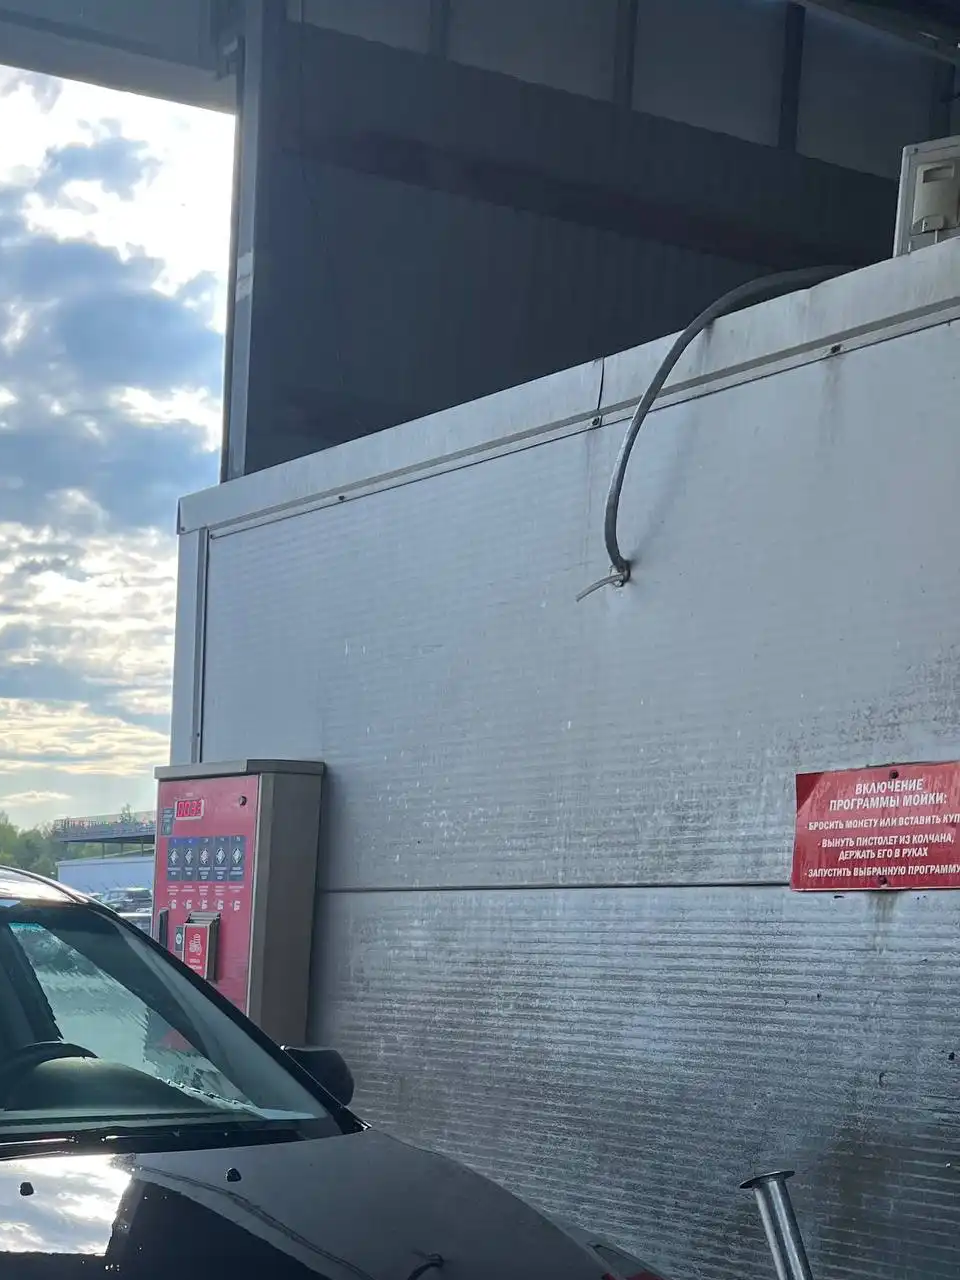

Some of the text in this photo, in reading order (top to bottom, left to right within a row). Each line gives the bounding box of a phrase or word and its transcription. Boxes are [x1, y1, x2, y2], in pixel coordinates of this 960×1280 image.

[855, 779, 924, 795] ВКЛЮЧЕНИЕ
[829, 792, 947, 811] ПРОГРАММЫ МОЙКИ:
[808, 821, 844, 831] БРОСИТЬ
[845, 818, 878, 829] МОНЕТУ
[879, 817, 898, 827] ИЛИ
[899, 815, 941, 826] ВСТАВИТЬ
[822, 833, 954, 848] ВЫНУТЬ ПИСТОЛЕТ ИЗ КОЛЧАНА,
[838, 847, 929, 861] ДЕРЖАТЬ ЕГО В РУКАХ
[808, 867, 851, 878] ЗАПУСТИТЬ
[853, 865, 906, 876] ВЫБРАННУЮ
